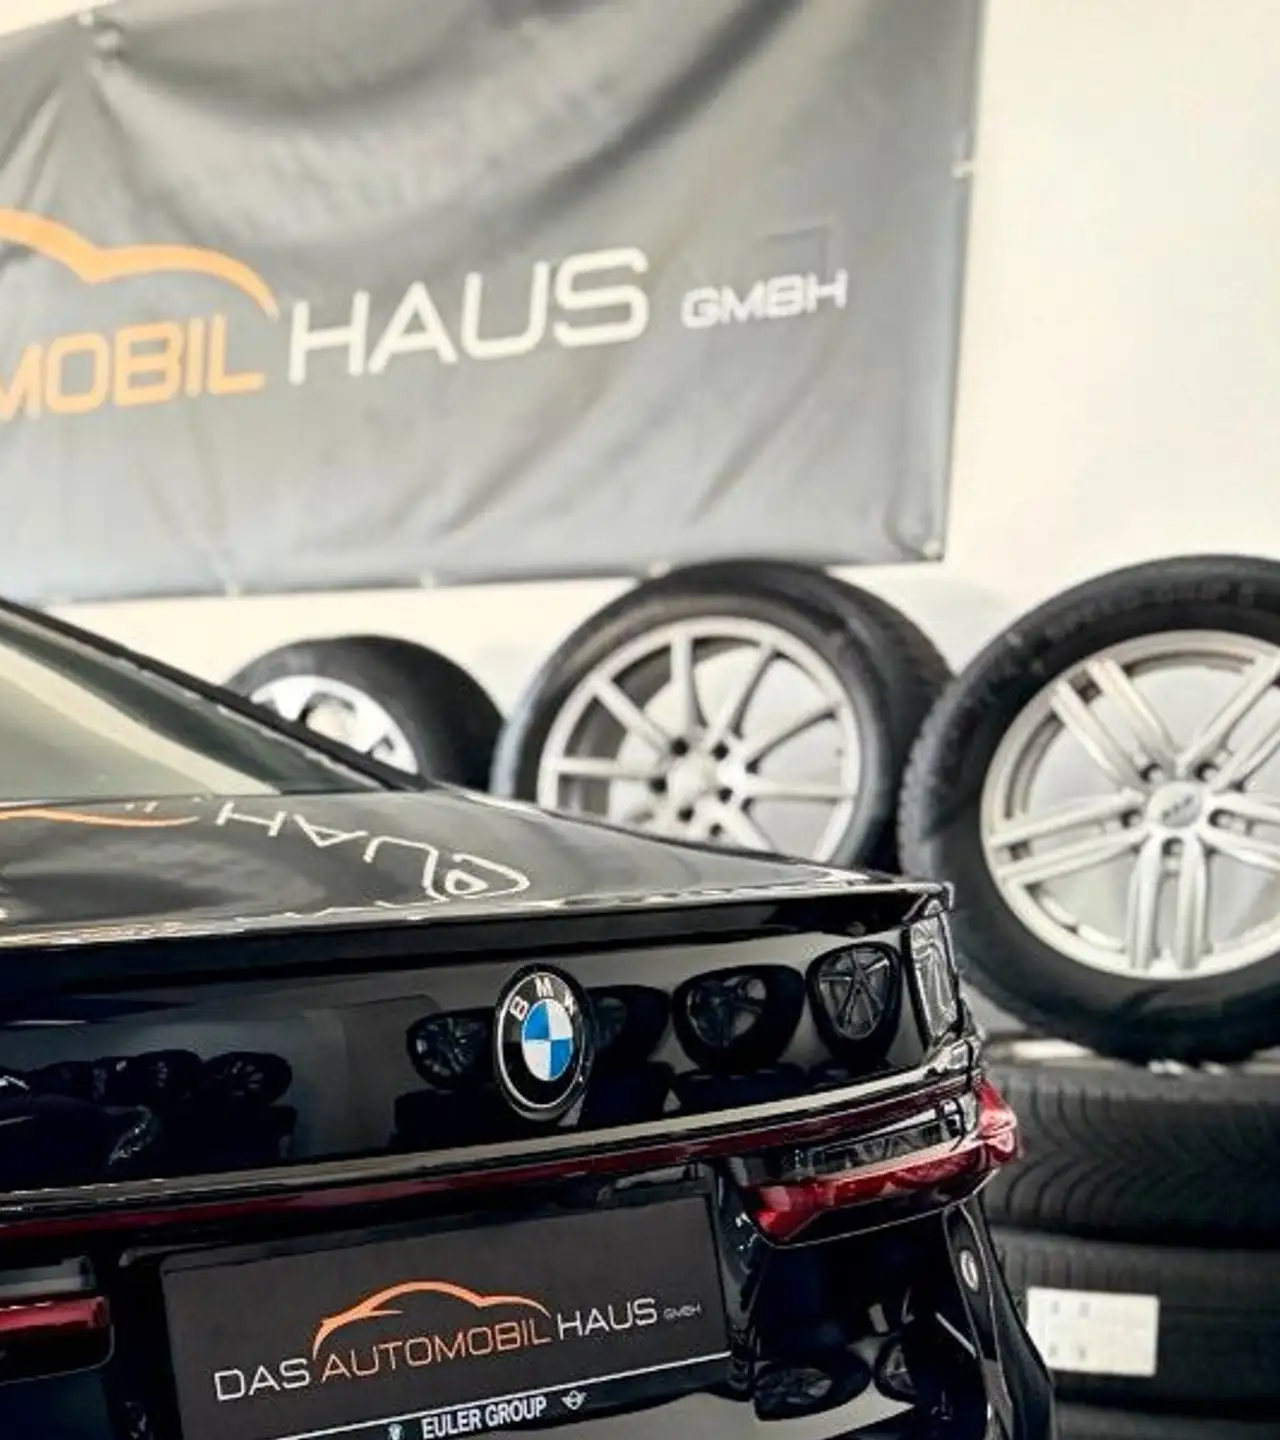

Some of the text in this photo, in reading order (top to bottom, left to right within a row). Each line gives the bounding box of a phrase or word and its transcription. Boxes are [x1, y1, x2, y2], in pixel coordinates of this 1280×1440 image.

[288, 247, 649, 386] HAUS
[681, 269, 849, 329] GMBH
[214, 1358, 310, 1402] DAS
[321, 1316, 551, 1383] AUTOMOBIL
[556, 1298, 658, 1340] HAUS
[421, 1396, 548, 1440] EULER GROUP
